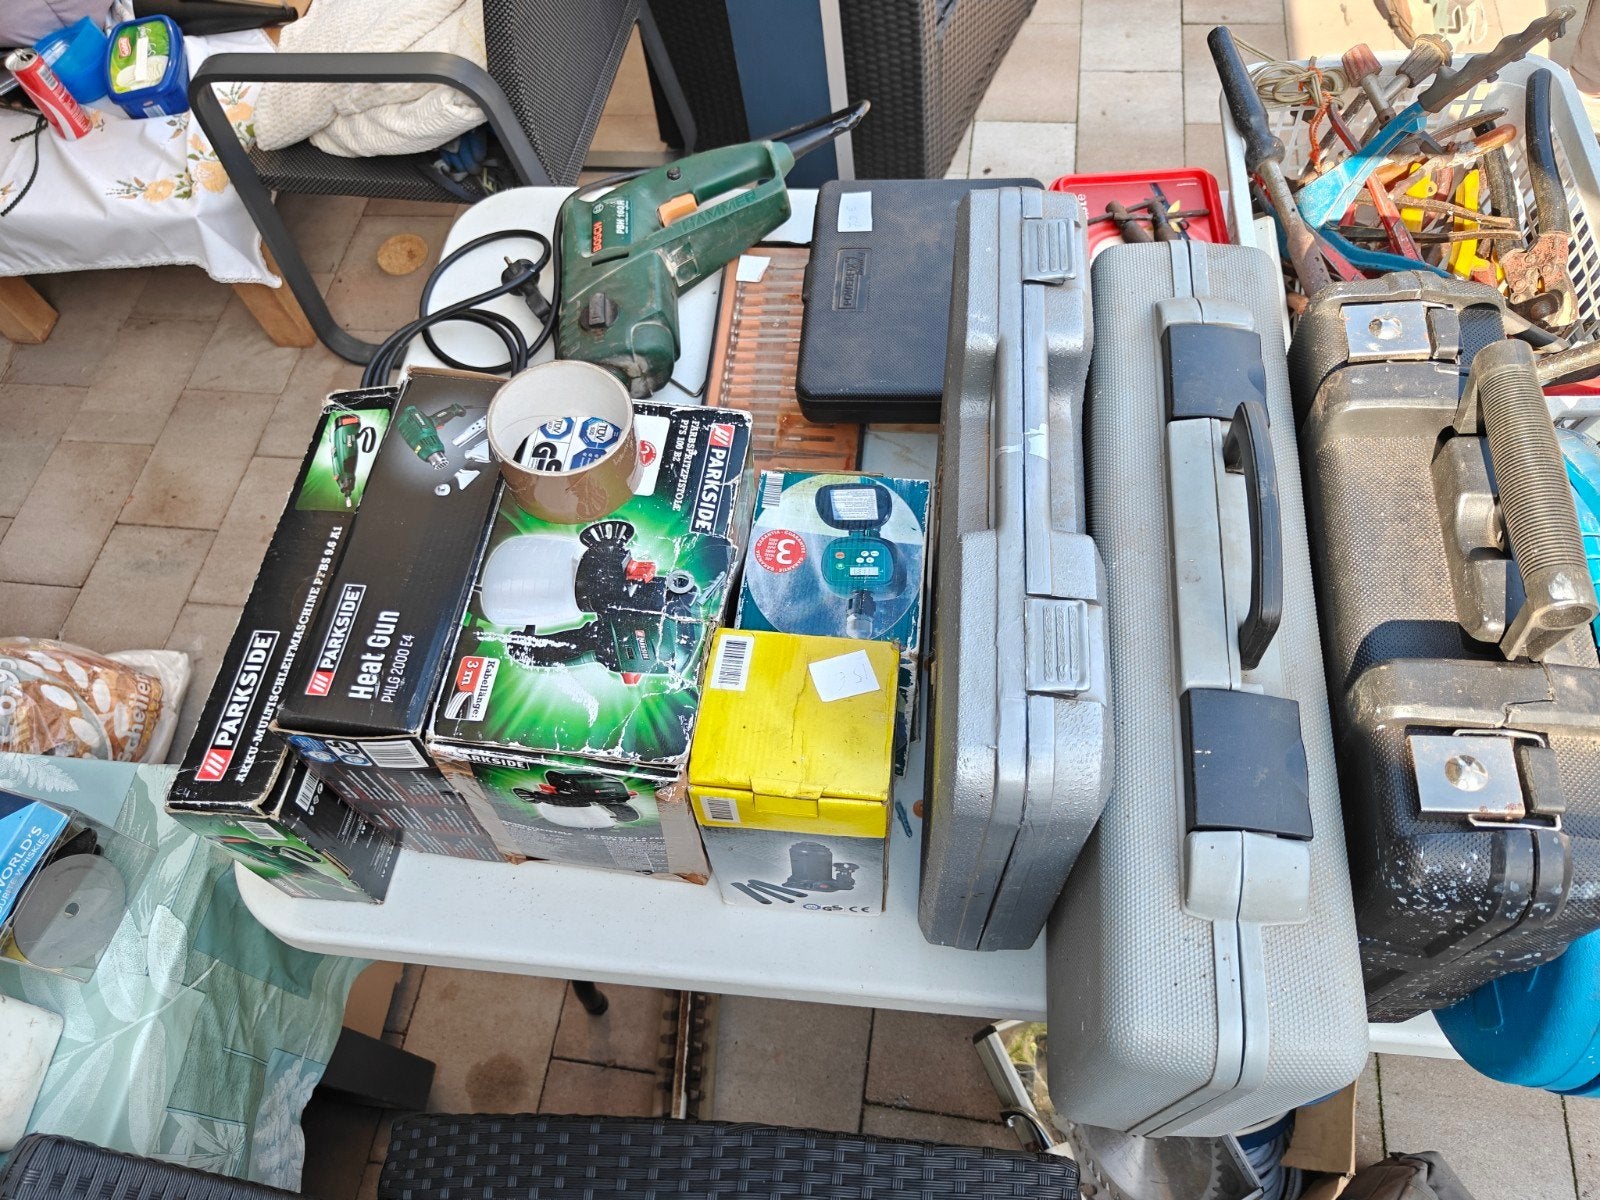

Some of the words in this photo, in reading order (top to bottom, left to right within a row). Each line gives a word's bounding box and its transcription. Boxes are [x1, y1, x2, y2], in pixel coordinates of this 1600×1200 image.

[592, 221, 603, 252] BOSCH
[679, 420, 688, 434] PFS
[673, 451, 681, 462] B2
[675, 437, 685, 449] 100
[672, 421, 699, 511] FARBSPRITZPISTOLE
[695, 448, 726, 530] PARKSIDE
[776, 539, 796, 564] 3
[320, 590, 360, 668] PARKSIDE
[366, 610, 400, 648] Gun
[400, 634, 415, 647] E4
[235, 586, 320, 781] AKKU-MULTISCHLEIFMASCHINE
[313, 556, 332, 586] PFBS
[330, 524, 343, 540] A1
[390, 649, 410, 675] 2000
[467, 661, 478, 669] 3
[348, 651, 385, 699] Heat
[381, 676, 401, 702] PHLG
[461, 671, 473, 685] m
[214, 635, 273, 747] PARKSIDE
[472, 661, 495, 718] Kabellänge:
[466, 752, 525, 769] ARKSIDE
[15, 832, 50, 876] WHISKIES
